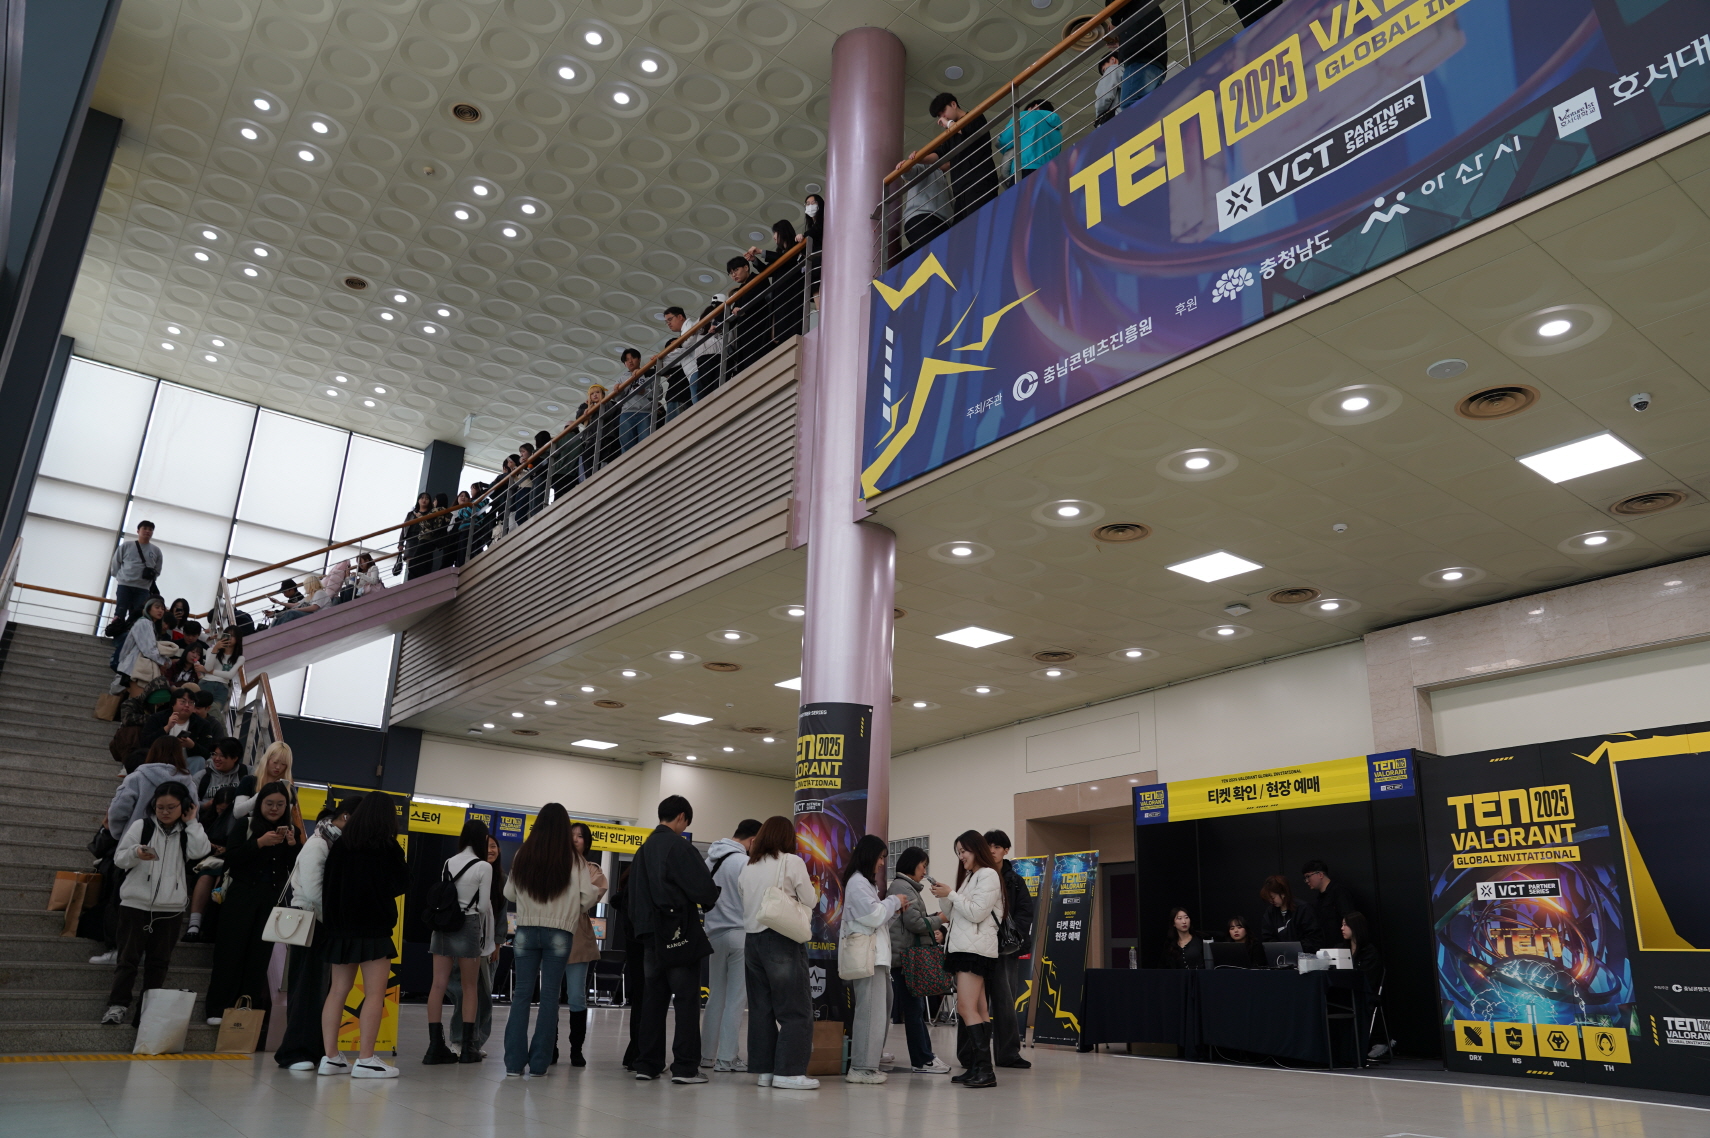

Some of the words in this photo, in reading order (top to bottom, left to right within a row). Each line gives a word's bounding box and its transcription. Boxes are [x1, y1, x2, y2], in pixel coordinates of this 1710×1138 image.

[1325, 14, 1420, 79] GLOBAL
[1344, 94, 1415, 142] PARTNER
[1069, 89, 1222, 229] TEN
[1229, 46, 1297, 134] 2025
[1346, 117, 1399, 154] SERIES
[1267, 138, 1334, 194] VCT
[1175, 296, 1198, 316] 후원
[1259, 230, 1332, 280] 충청남도
[966, 393, 1002, 419] 주최/주관
[1043, 317, 1153, 385] 충남콘텐츠진흥원
[818, 737, 841, 756] 2025
[1373, 760, 1395, 771] TEN
[1208, 787, 1231, 804] 티켓
[1233, 784, 1257, 801] 확인
[1260, 784, 1264, 799] /
[1266, 779, 1291, 798] 현장
[1293, 776, 1320, 793] 예매
[410, 810, 441, 825] 스토어
[1447, 788, 1531, 829] TEN
[1534, 788, 1569, 819] 2025
[610, 832, 643, 846] 인디게임
[1451, 823, 1576, 851] VALORANT
[1457, 855, 1495, 865] GLOBAL
[1497, 850, 1576, 863] INVITATIONAL
[1498, 884, 1525, 896] VCT
[1055, 931, 1067, 941] 현장
[1068, 931, 1080, 941] 예매
[1056, 920, 1068, 930] 티켓
[1069, 920, 1081, 930] 확인
[667, 939, 688, 948] KANGOL
[807, 942, 836, 950] TEAMS
[1490, 927, 1562, 957] TEN
[1663, 1017, 1698, 1031] TEN
